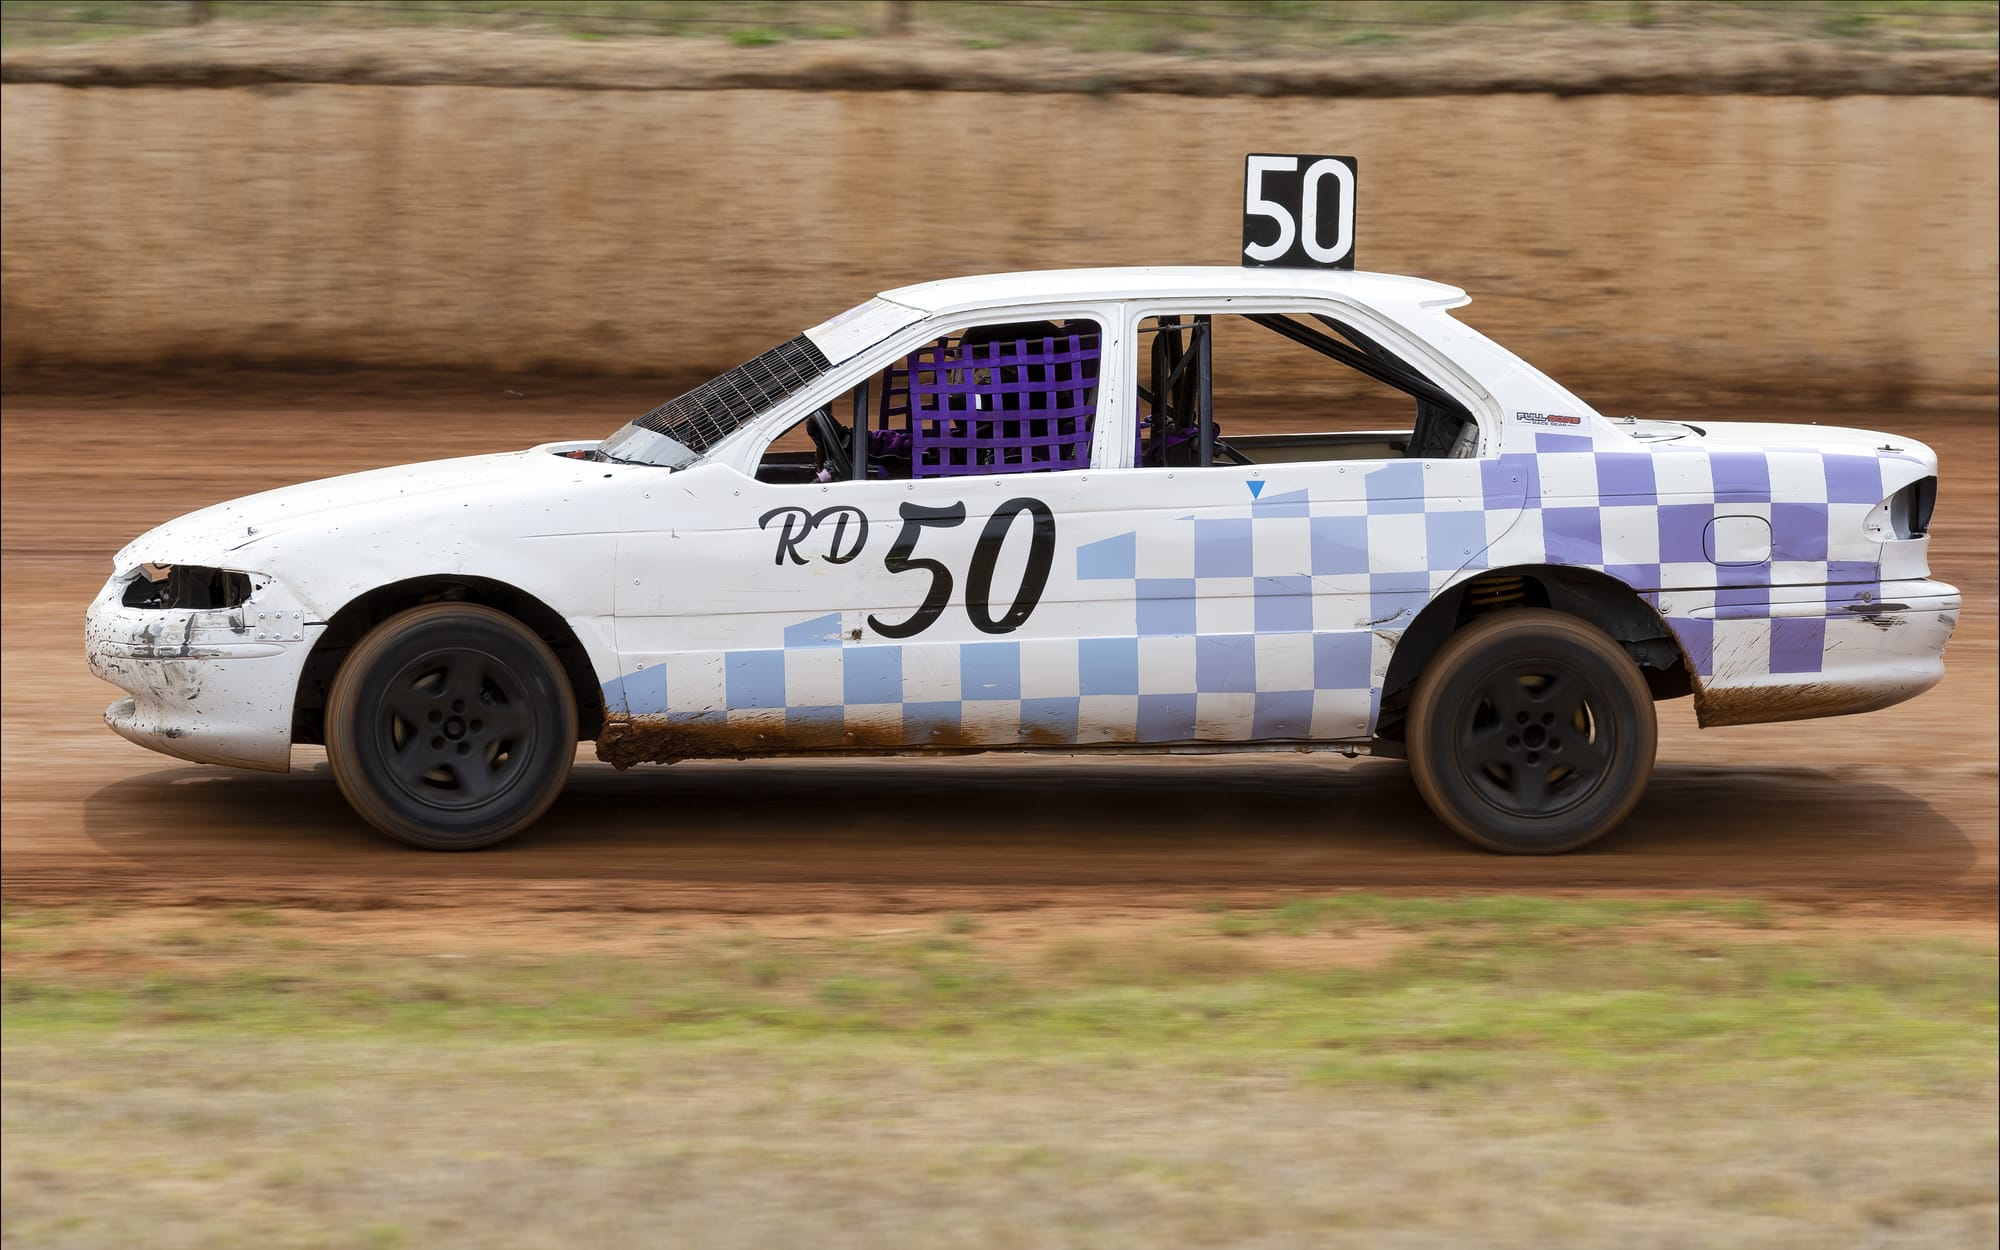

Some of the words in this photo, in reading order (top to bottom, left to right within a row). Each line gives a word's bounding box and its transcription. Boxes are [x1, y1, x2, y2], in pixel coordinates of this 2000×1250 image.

[1244, 155, 1354, 263] 50
[758, 505, 869, 566] RD
[867, 496, 1056, 639] 50
